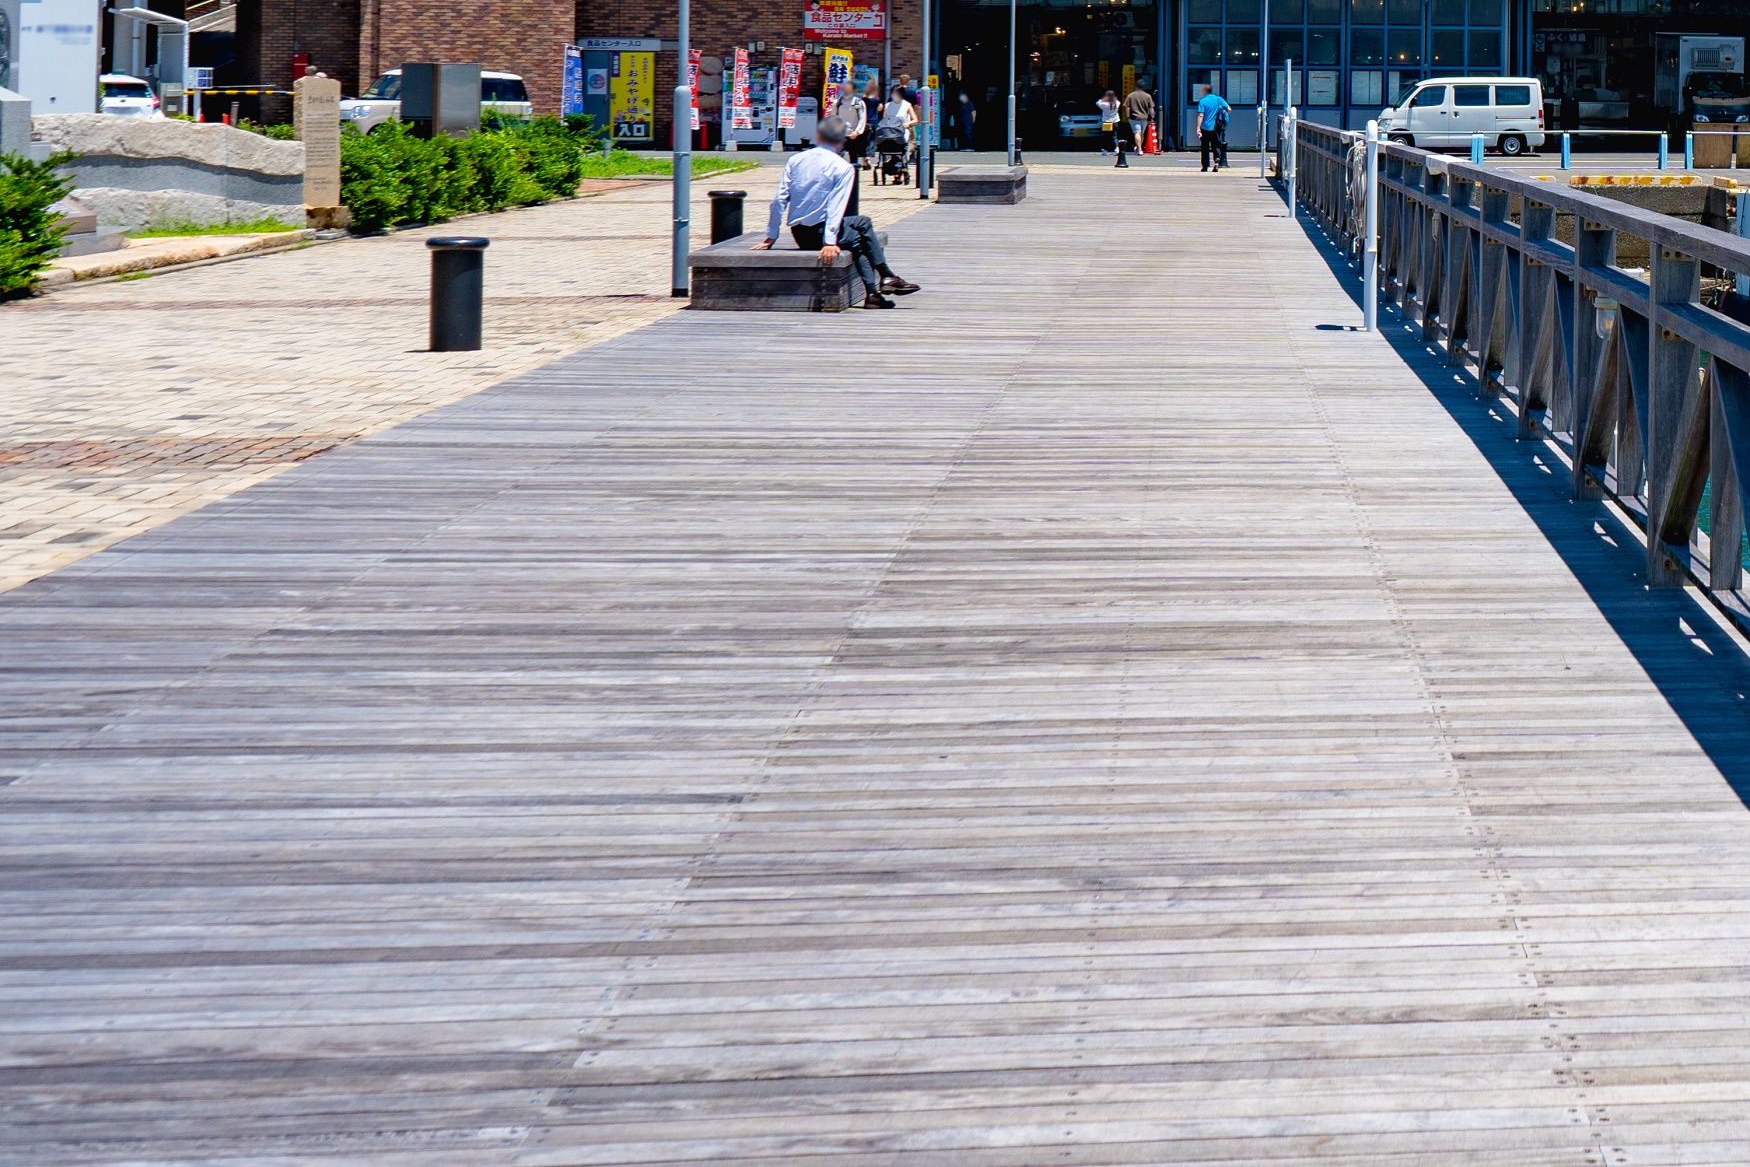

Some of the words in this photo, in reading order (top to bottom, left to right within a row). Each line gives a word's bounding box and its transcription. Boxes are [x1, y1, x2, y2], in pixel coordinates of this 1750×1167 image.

[811, 12, 872, 23] 食品センター
[828, 62, 849, 84] 鮭
[627, 69, 639, 123] おみやげ通り
[619, 123, 645, 136] 入口
